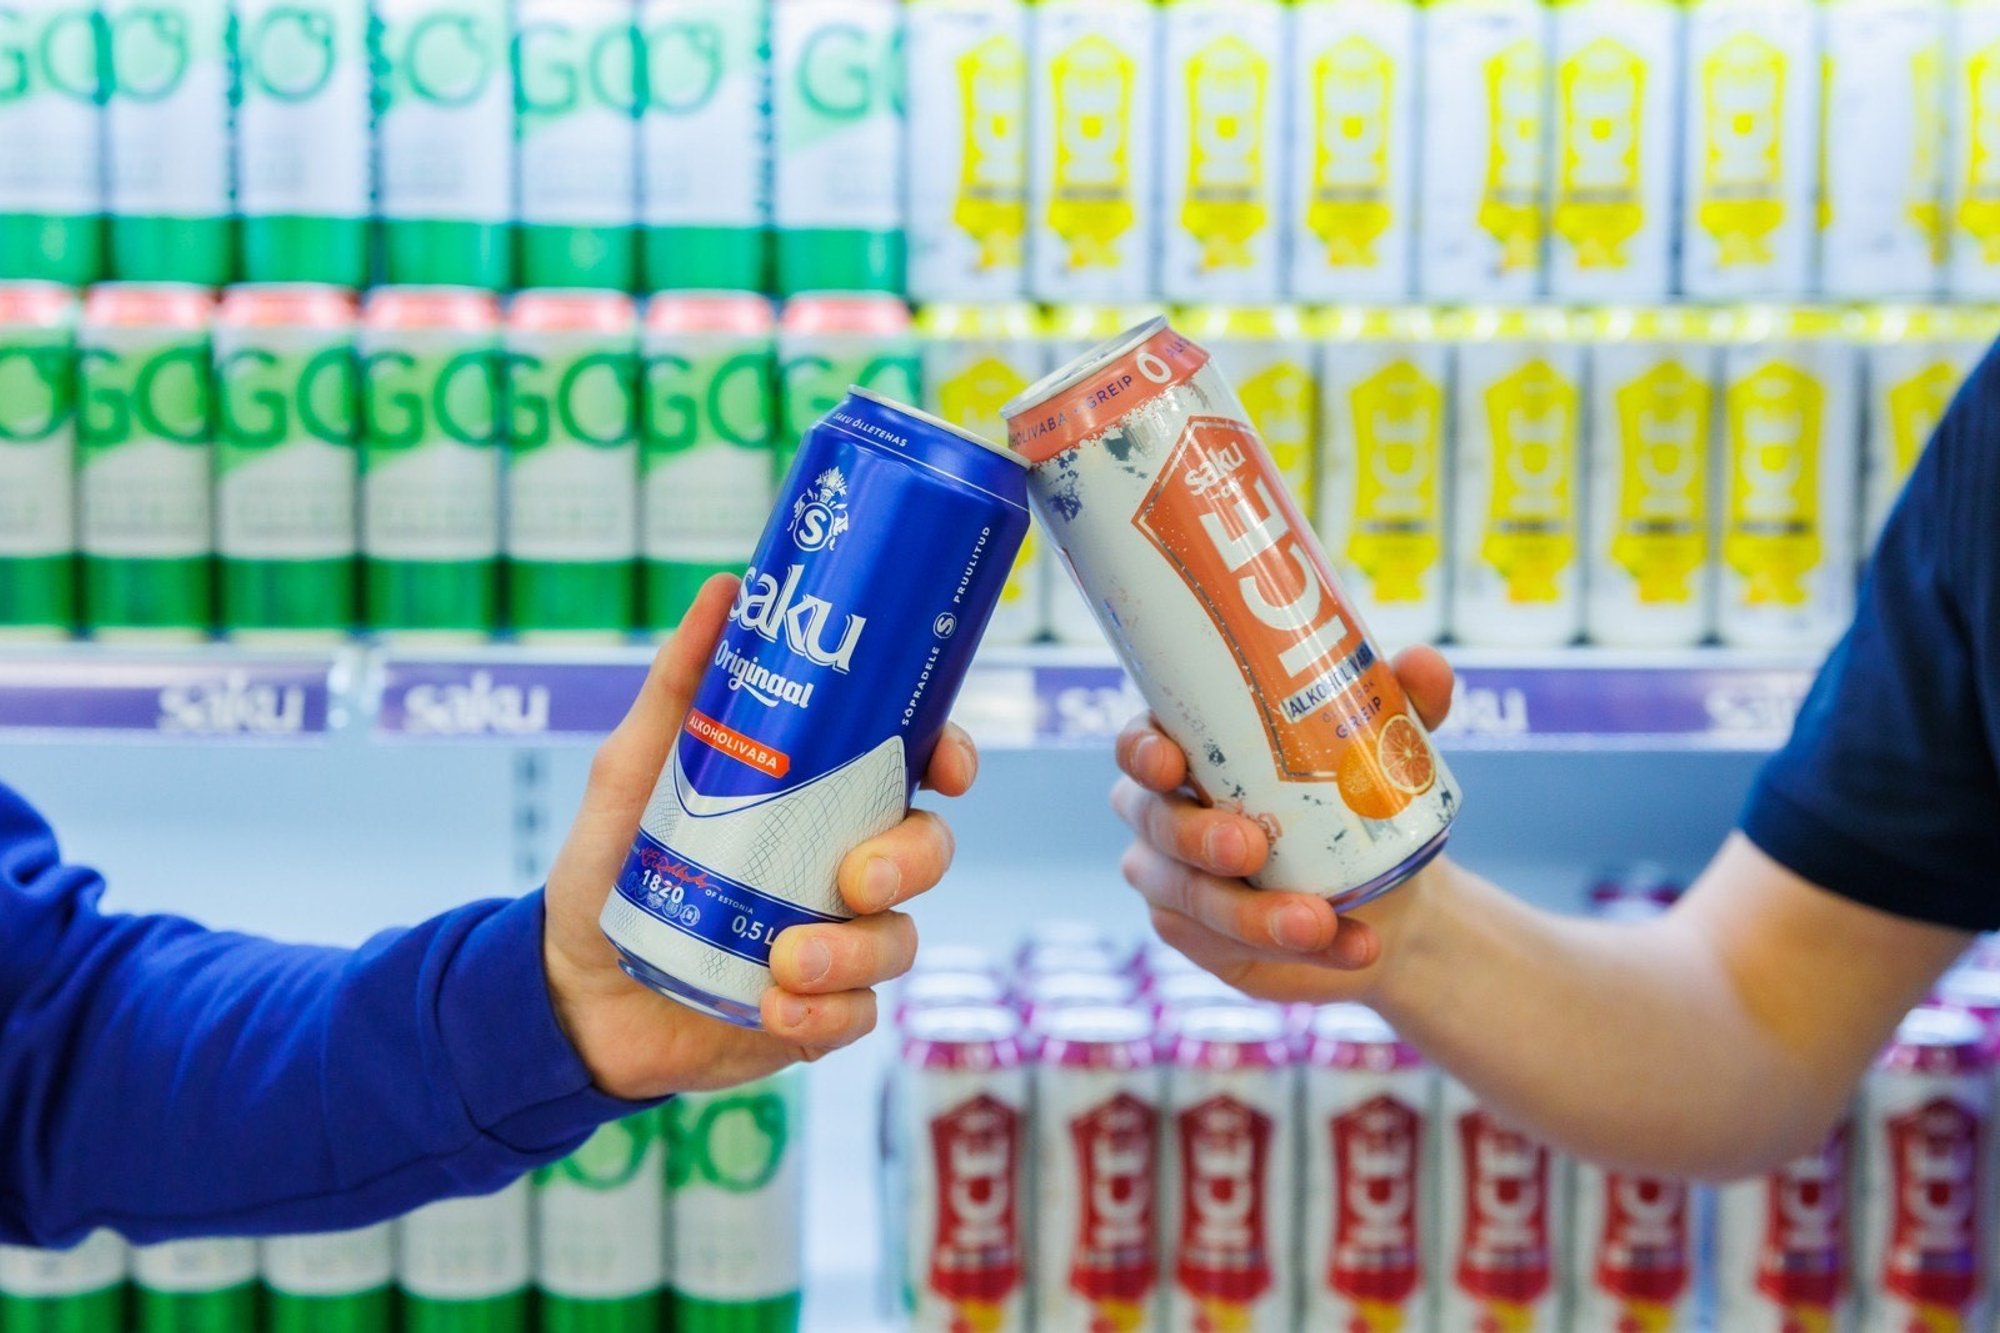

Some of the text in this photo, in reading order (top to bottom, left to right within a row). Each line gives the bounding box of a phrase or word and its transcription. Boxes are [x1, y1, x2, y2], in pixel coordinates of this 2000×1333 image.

[213, 346, 356, 450] GO
[361, 350, 500, 451] GO
[502, 352, 639, 453] GO
[642, 354, 773, 454] GO
[1085, 375, 1133, 409] GREIP
[852, 417, 909, 449] ÕLLETEHAS
[1184, 441, 1247, 497] saku
[1199, 474, 1349, 679] ICE
[728, 564, 867, 675] saku
[902, 646, 941, 727] SÕPRADELE
[953, 526, 991, 604] PRUULITUD
[158, 669, 306, 732] saku
[403, 670, 551, 733] saku
[714, 639, 815, 709] Originaal
[688, 714, 778, 770] ALKOHOLIVABA
[1335, 695, 1383, 740] GREIP
[641, 868, 685, 904] 1820
[718, 894, 754, 915] ESTONIA
[731, 914, 764, 941] 0,5
